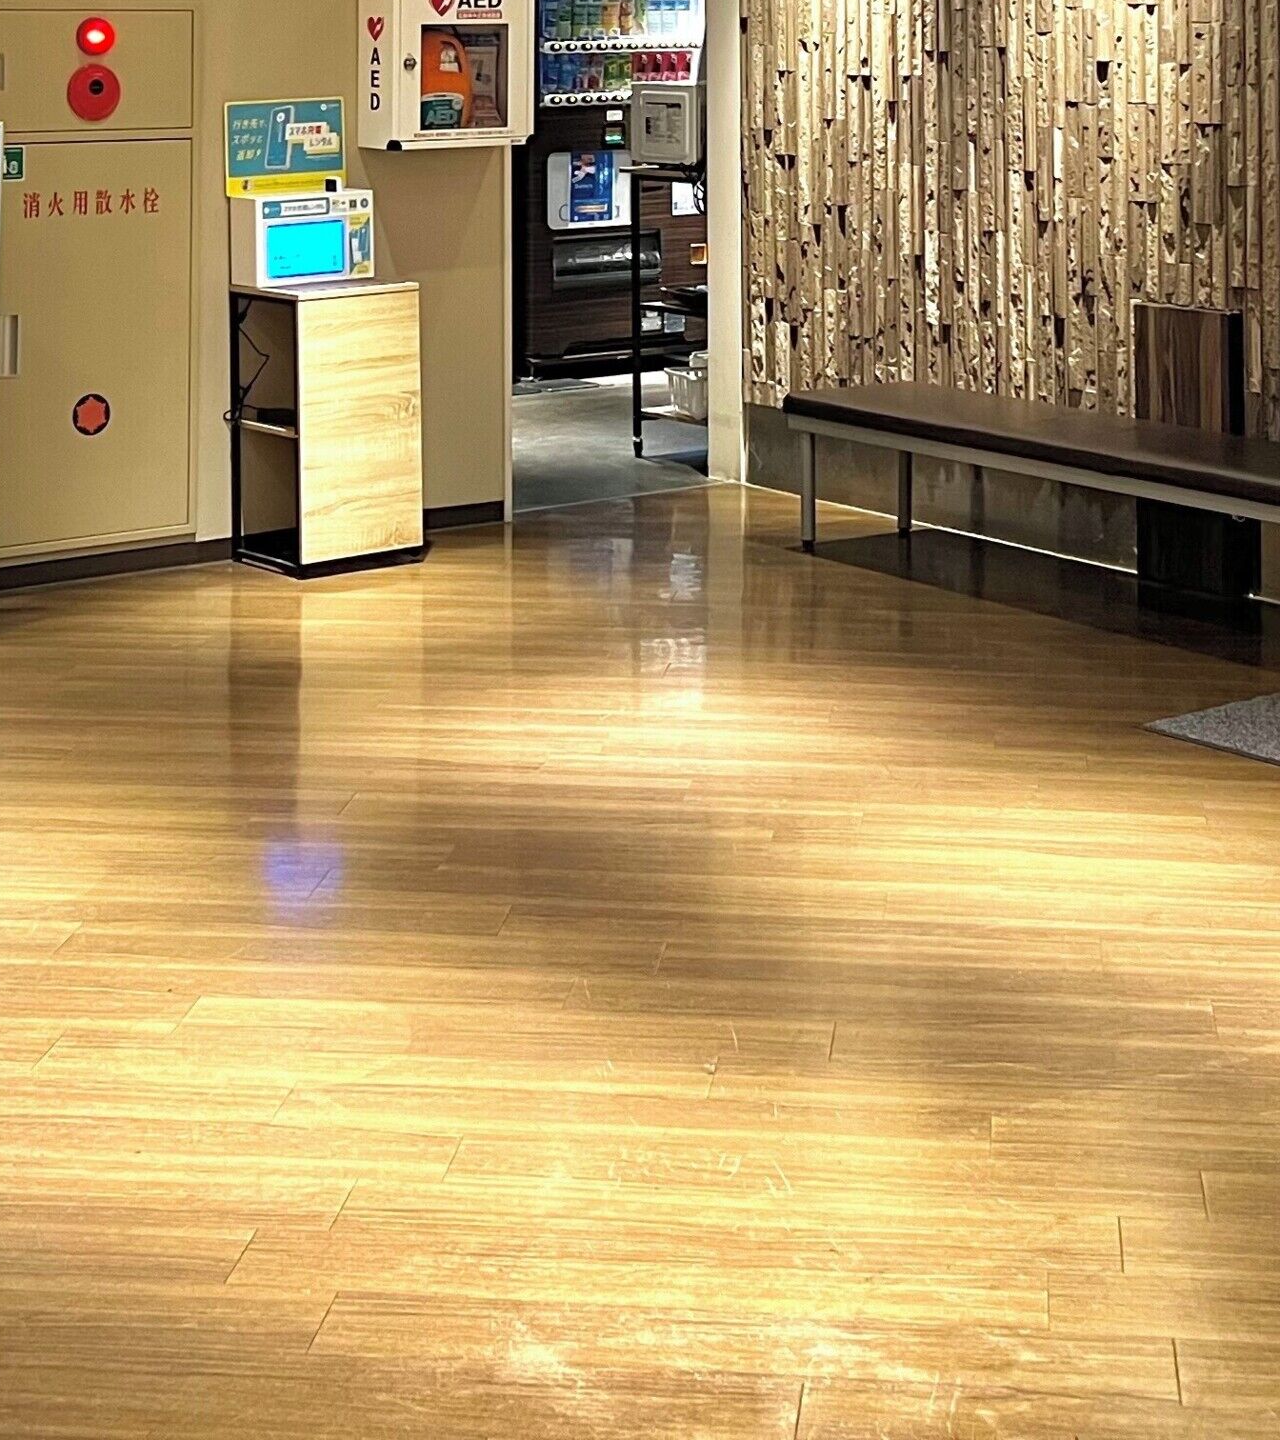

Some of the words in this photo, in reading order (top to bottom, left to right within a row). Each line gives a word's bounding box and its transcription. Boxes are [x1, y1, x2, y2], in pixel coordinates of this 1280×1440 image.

[370, 47, 381, 111] AED
[424, 110, 459, 126] AED
[23, 187, 160, 219] 消火用散水栓
